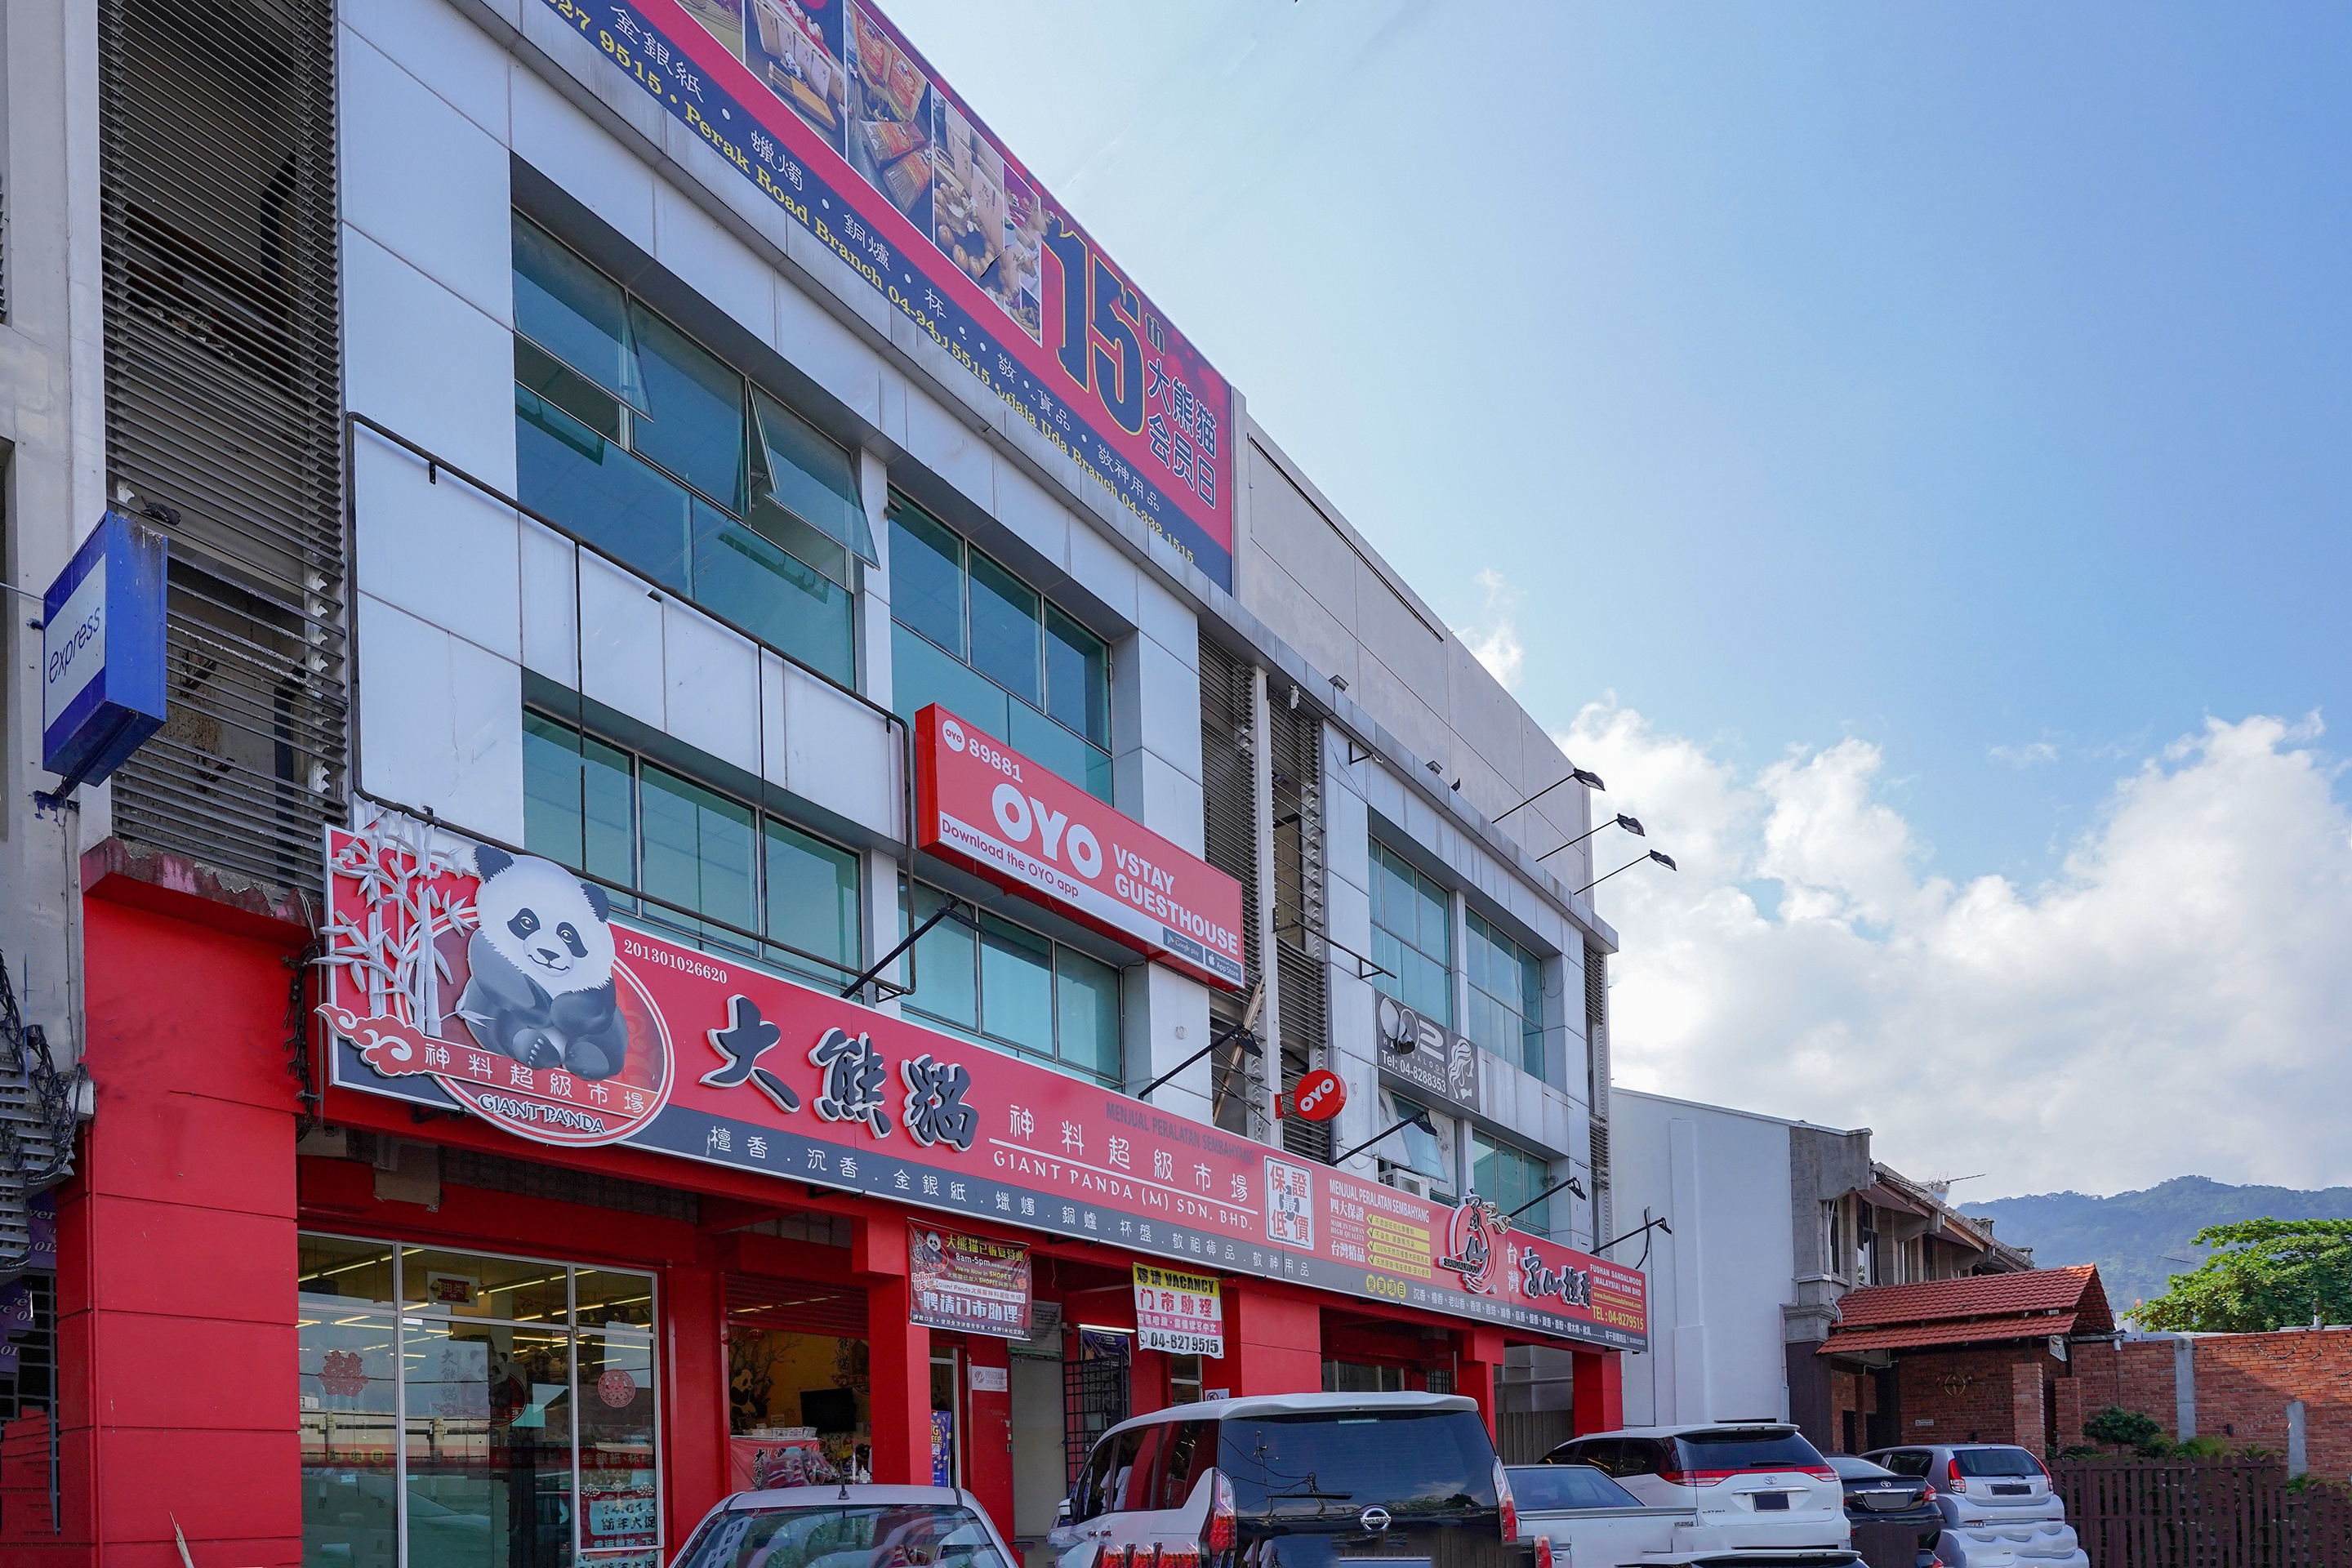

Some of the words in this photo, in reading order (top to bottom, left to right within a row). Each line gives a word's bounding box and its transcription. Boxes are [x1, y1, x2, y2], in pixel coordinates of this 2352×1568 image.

[610, 6, 704, 103] 金銀紙
[1097, 443, 1160, 512] 敬神用品
[548, 0, 590, 30] 27
[599, 30, 662, 95] 9515
[684, 100, 751, 174] Perak
[755, 164, 809, 226] Road
[814, 216, 884, 292] Branch
[1071, 446, 1119, 500] Branch
[1166, 533, 1195, 564] 1515
[1147, 358, 1217, 460] 大熊猫
[1147, 412, 1217, 510] 会员日
[49, 608, 100, 684] express
[945, 728, 963, 743] OYO
[969, 738, 1023, 783] 89881
[991, 783, 1102, 880] OYO
[942, 819, 1004, 861] Download
[1007, 852, 1025, 871] the
[1028, 863, 1054, 885] OYO
[1057, 877, 1079, 898] app
[1112, 843, 1175, 895] VSTAY
[1115, 873, 1239, 956] GUESTHOUSE
[624, 939, 728, 984] 201301026620
[425, 1043, 644, 1113] 神料超級市場
[1381, 1049, 1398, 1070] Tel:
[1400, 1060, 1446, 1093] 04-8288353
[1411, 1052, 1446, 1075] SALOON
[1299, 1078, 1334, 1111] OYO
[1106, 1102, 1149, 1132] MENJUAL
[1152, 1116, 1200, 1146] PERALATAN
[1009, 1104, 1249, 1202] 神料超級市場
[994, 1151, 1061, 1180] GIANT
[1069, 1169, 1134, 1200] PANDA
[1141, 1187, 1169, 1211] (M)
[1177, 1199, 1213, 1221] SDN.
[1219, 1209, 1253, 1231] BHD.
[1269, 1165, 1307, 1199] 保證
[1329, 1178, 1359, 1202] MENJUAL
[1358, 1187, 1392, 1211] PERALATAN
[1392, 1198, 1429, 1223] SEMBAHYANG
[912, 1272, 935, 1282] Follow
[955, 1253, 991, 1267] 8am-5pm
[989, 1270, 1012, 1281] SHOPEE
[1136, 1267, 1162, 1286] 聘请
[1165, 1272, 1215, 1294] VACANCY
[1589, 1263, 1610, 1278] FUSHAN
[1610, 1270, 1642, 1286] SANDALWOOD
[914, 1281, 926, 1291] Us
[1140, 1288, 1212, 1317] 门市助理
[1593, 1276, 1621, 1291] (MALAYSIA)
[1608, 1310, 1644, 1330] 04-8279515
